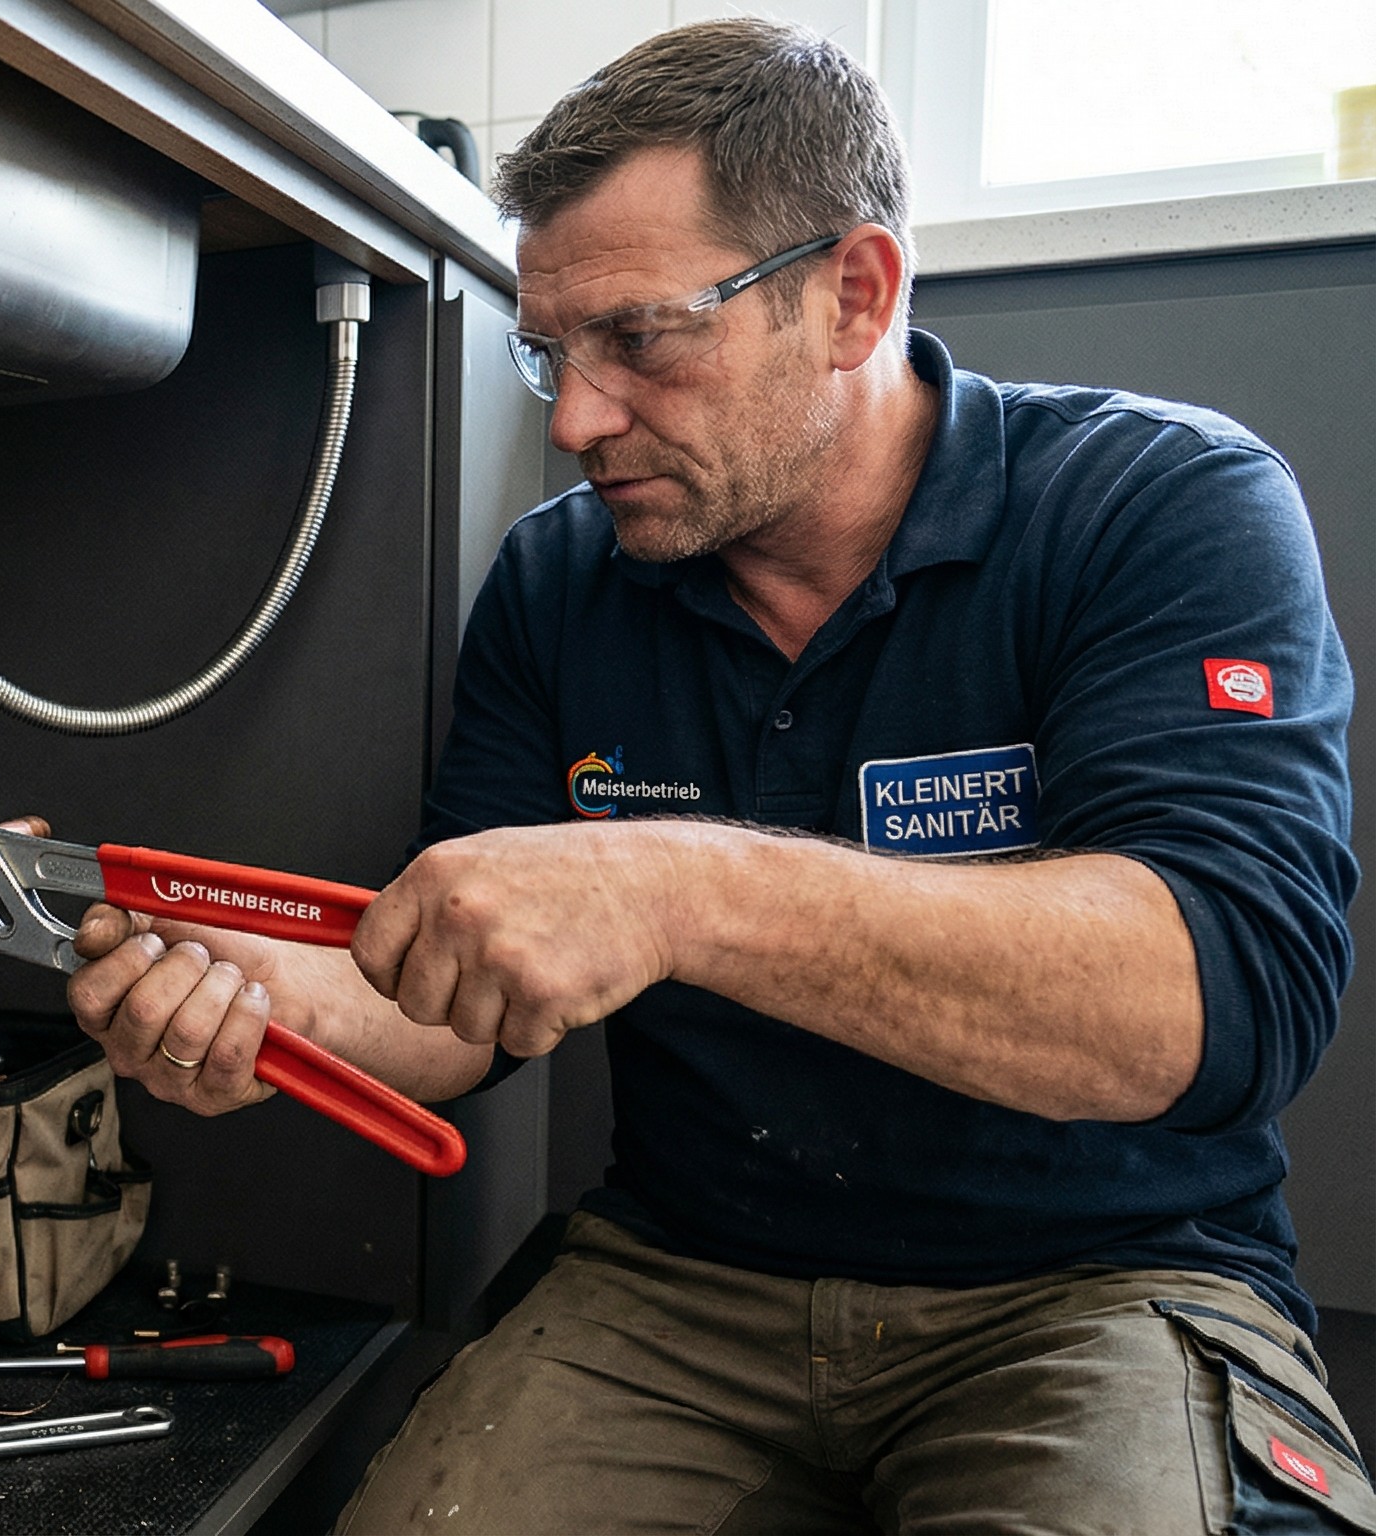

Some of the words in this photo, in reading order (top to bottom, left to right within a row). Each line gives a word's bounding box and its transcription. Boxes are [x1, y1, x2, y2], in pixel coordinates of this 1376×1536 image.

[582, 778, 701, 800] Meisterbetrieb
[875, 766, 1028, 807] KLEINERT
[885, 801, 1022, 840] SANITÄR
[169, 880, 322, 922] ROTHENBERGER
